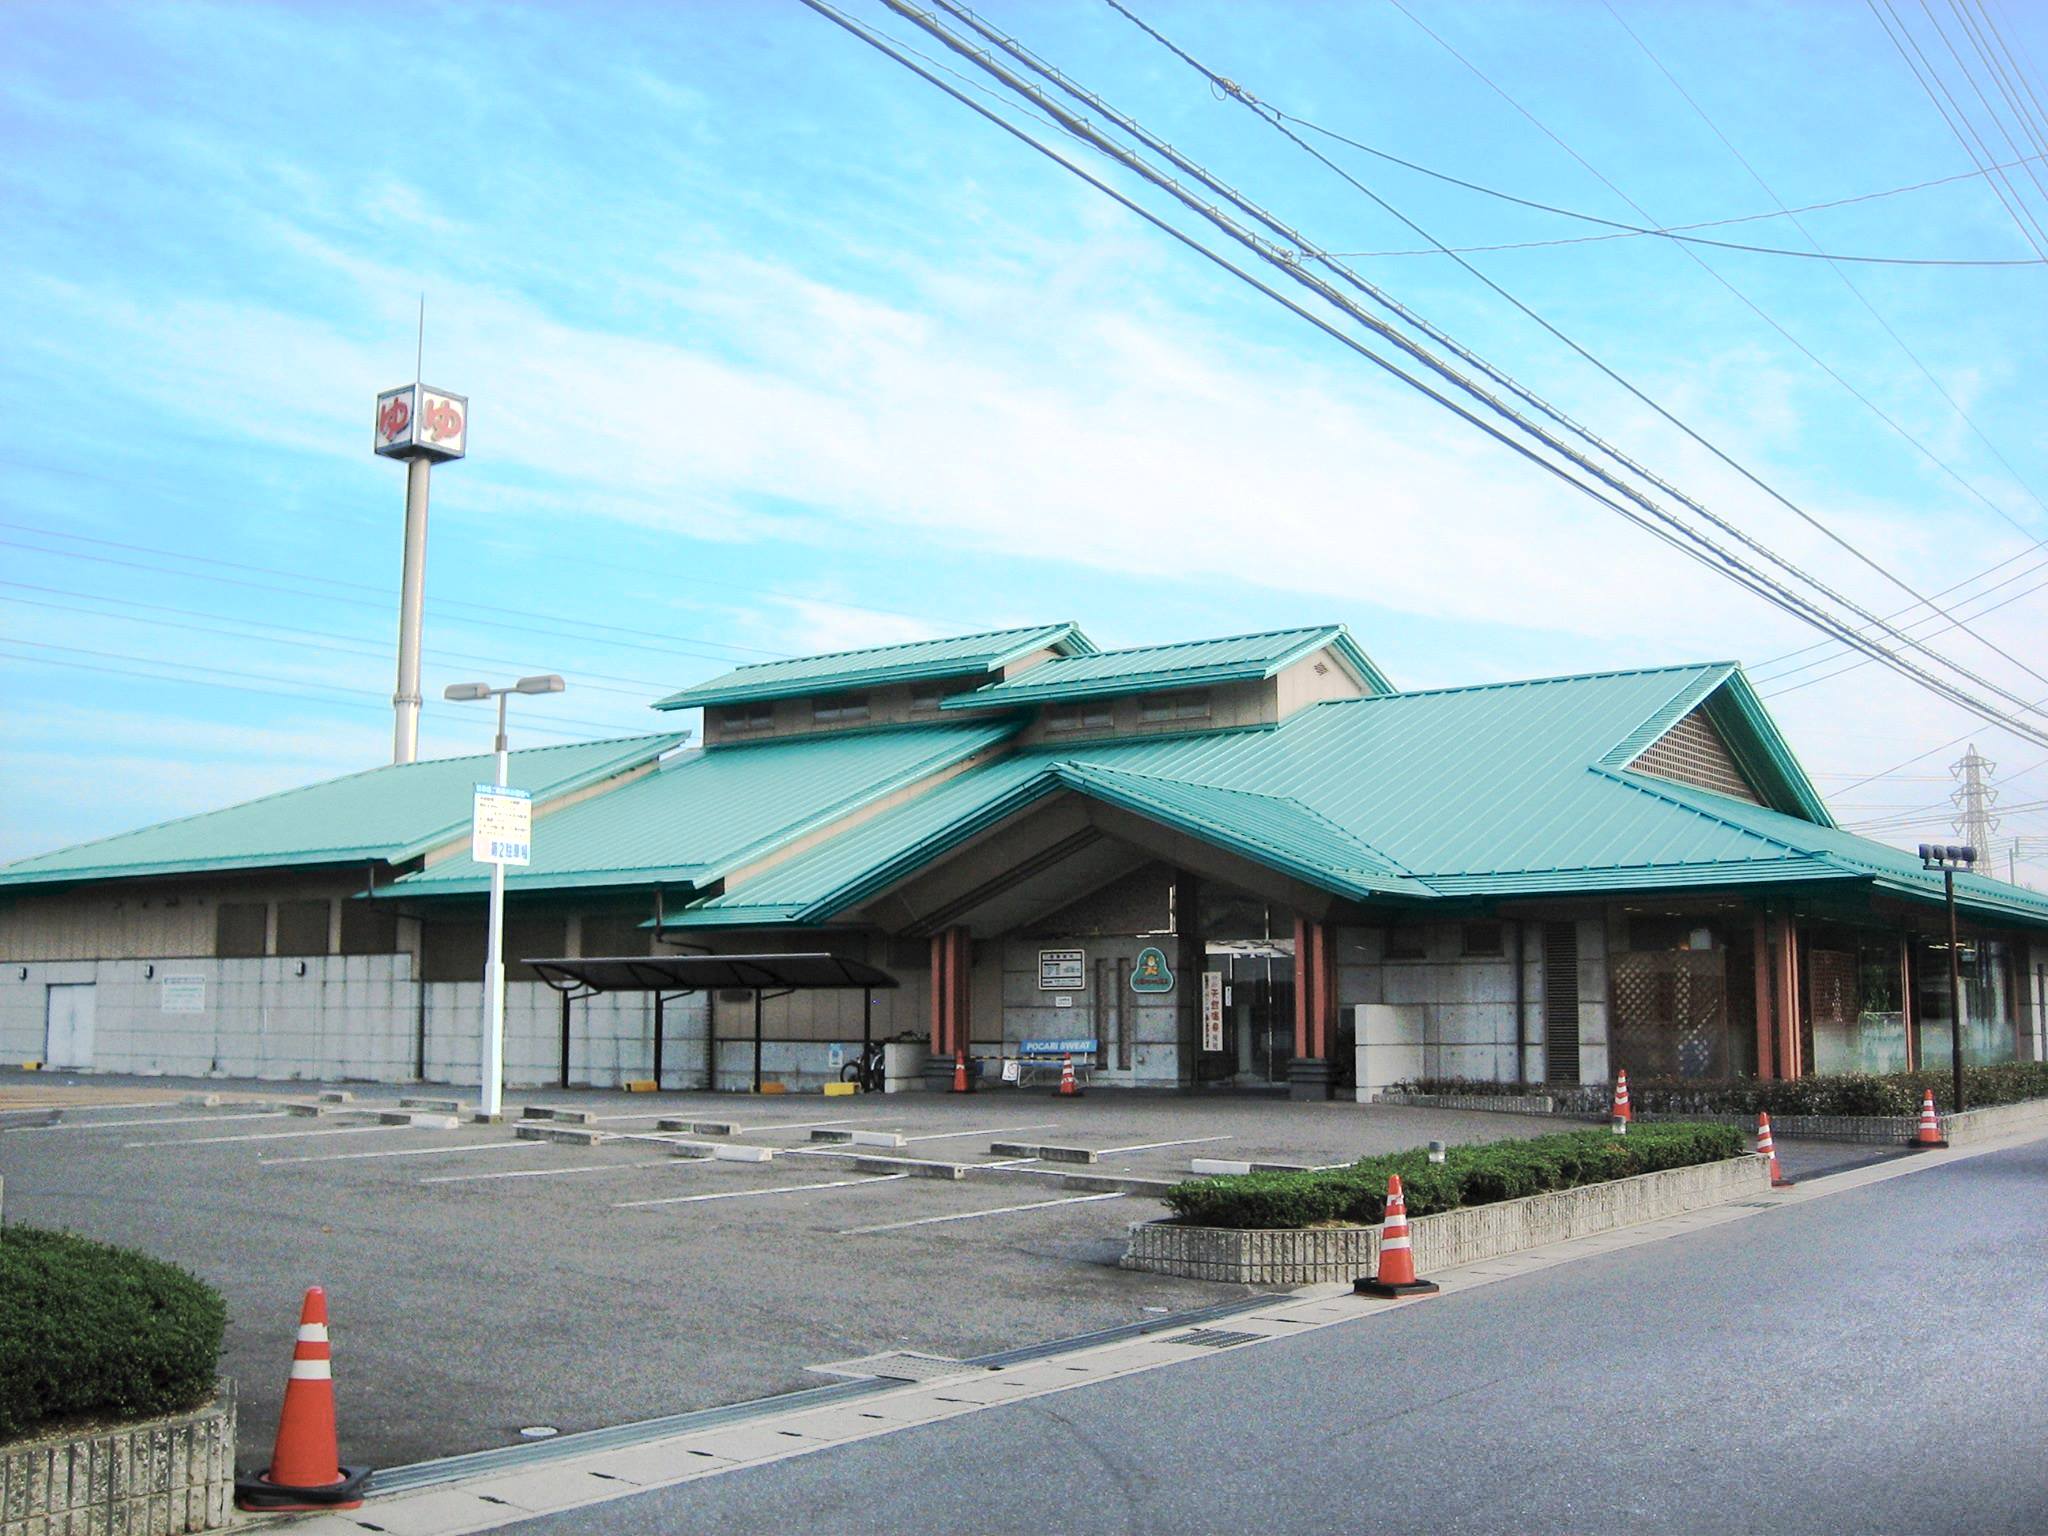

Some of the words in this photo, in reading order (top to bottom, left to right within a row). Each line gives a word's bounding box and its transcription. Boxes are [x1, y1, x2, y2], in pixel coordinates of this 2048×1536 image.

[380, 397, 409, 441] ゆ
[423, 399, 462, 441] ゆ
[1026, 1042, 1058, 1050] POCARI
[1060, 1041, 1090, 1050] SWEAT
